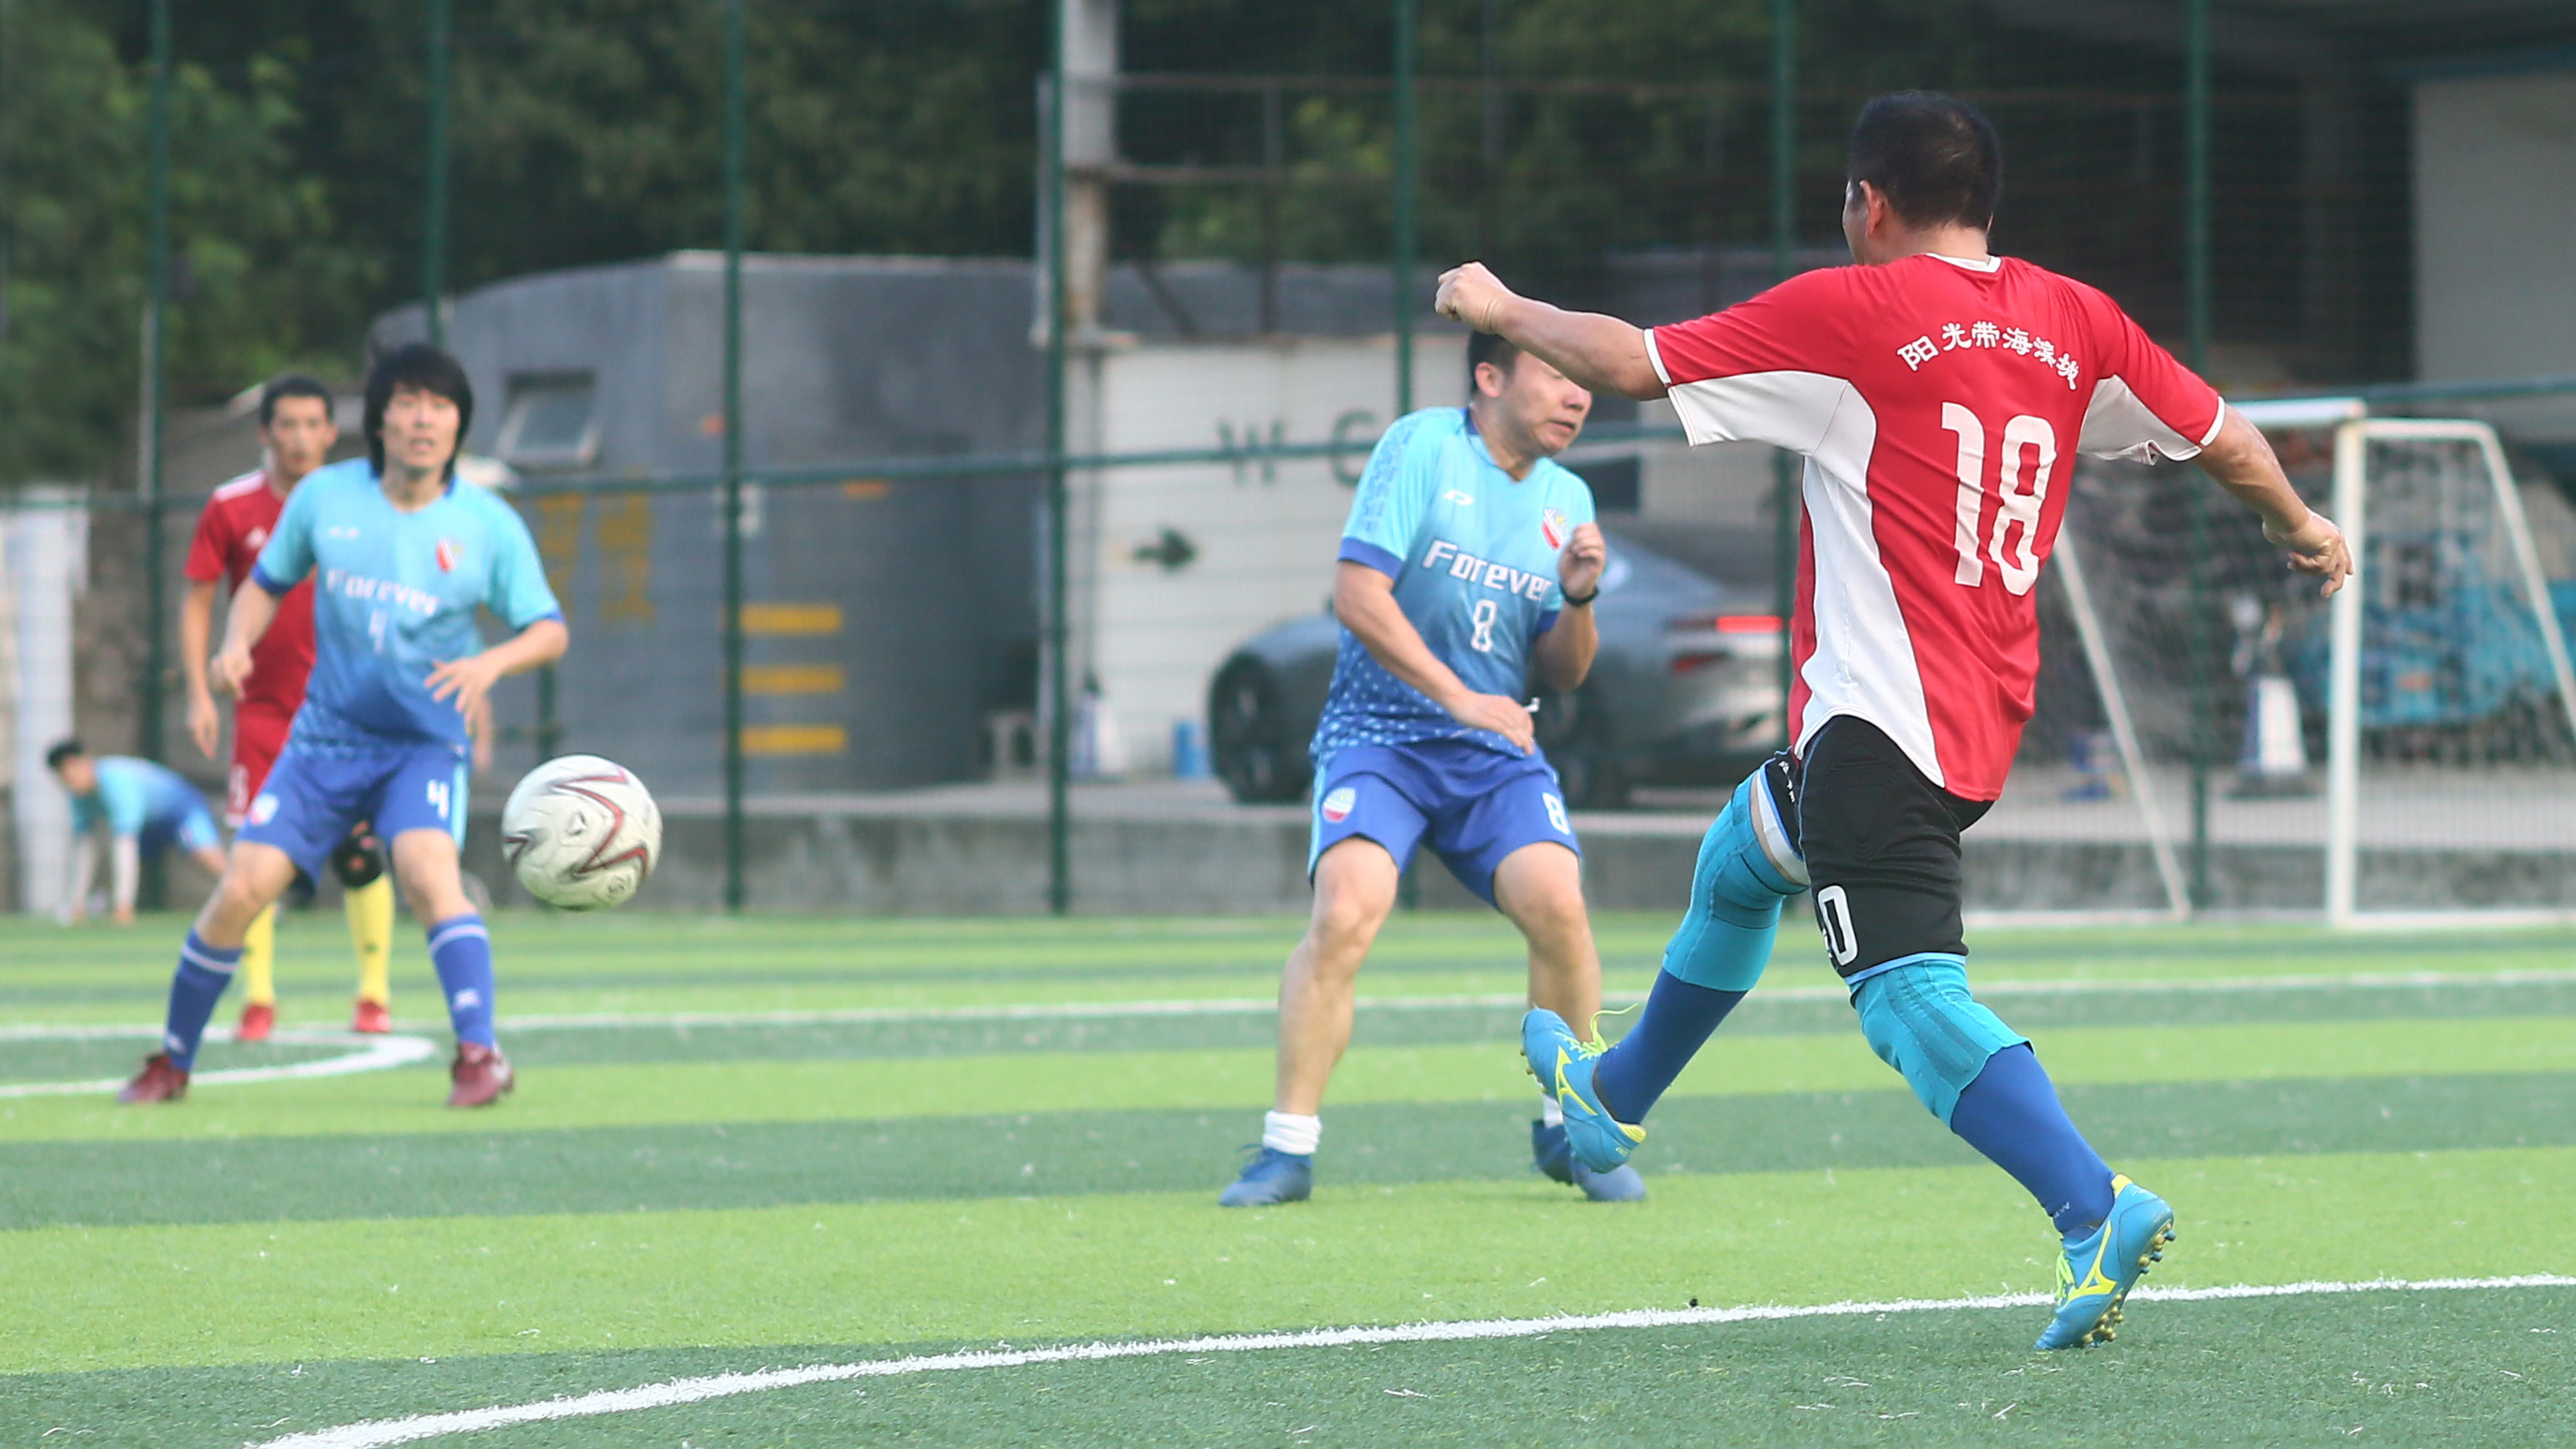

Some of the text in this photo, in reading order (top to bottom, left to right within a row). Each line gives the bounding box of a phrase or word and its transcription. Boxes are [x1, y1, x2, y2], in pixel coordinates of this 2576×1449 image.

[1942, 402, 2058, 596] 18
[1423, 539, 1552, 602] Forever
[1471, 599, 1497, 653] 8
[426, 779, 450, 820] 4
[1542, 792, 1571, 835] 8
